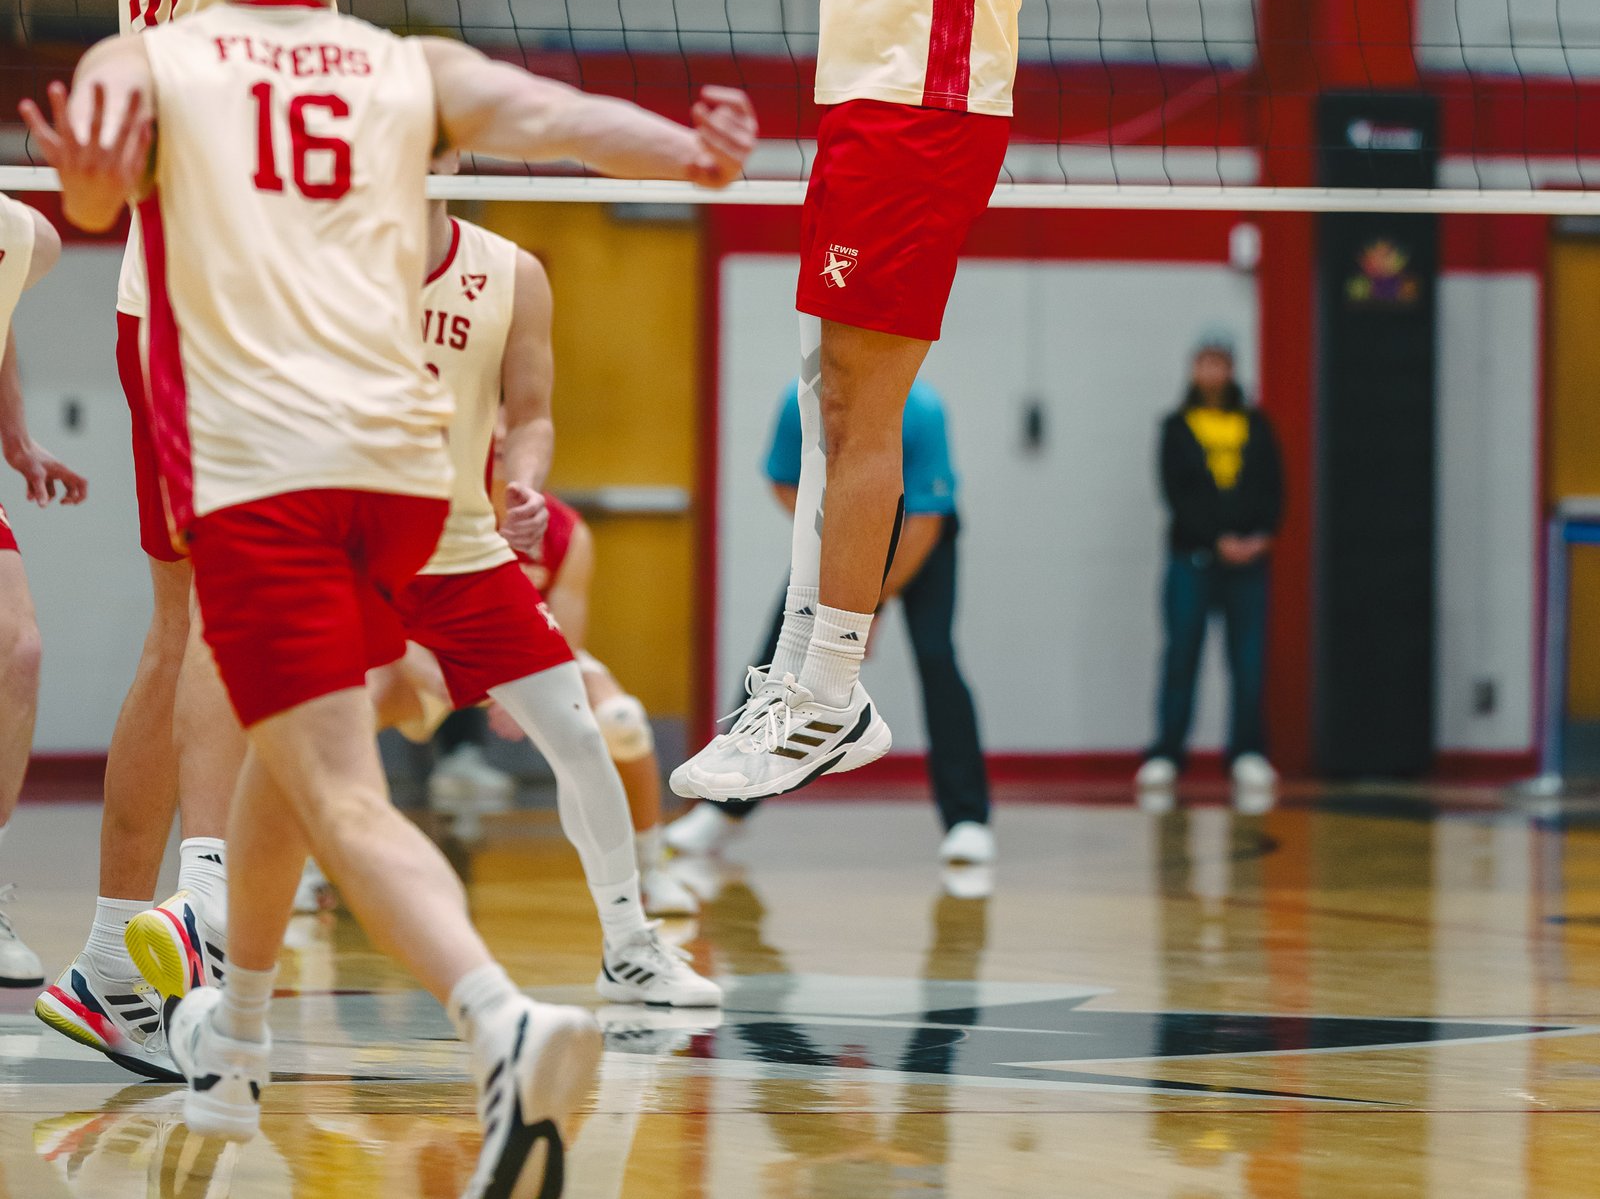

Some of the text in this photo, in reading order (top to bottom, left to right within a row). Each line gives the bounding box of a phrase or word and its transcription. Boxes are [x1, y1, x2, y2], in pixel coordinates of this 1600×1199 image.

[213, 34, 373, 77] FLYERS
[251, 82, 352, 199] 16
[829, 243, 859, 257] LEWIS
